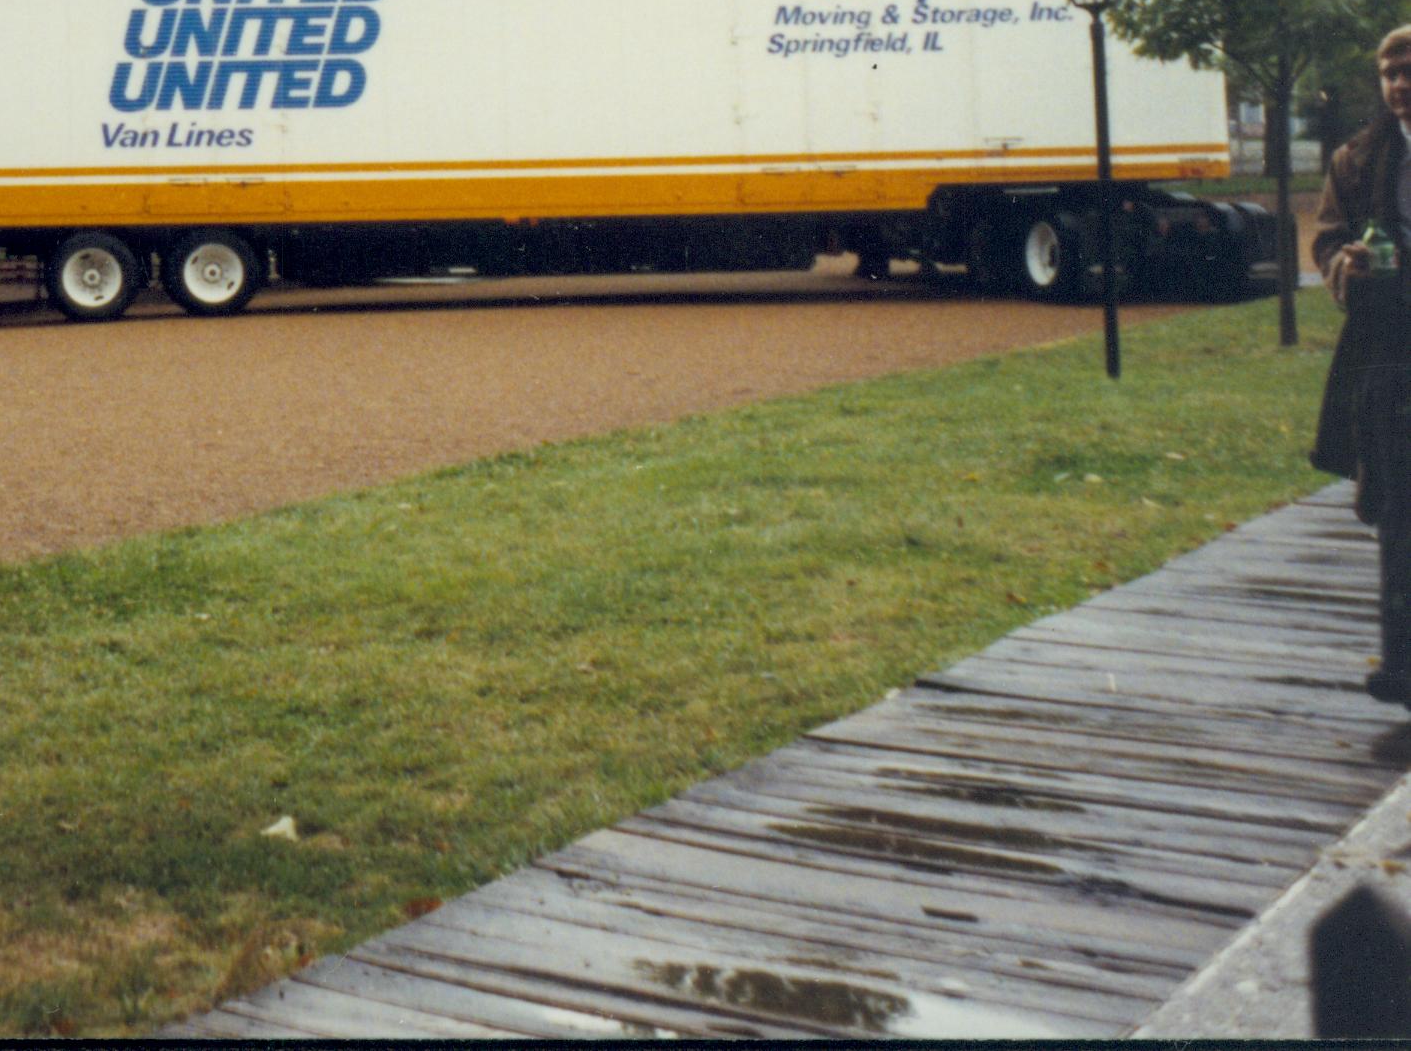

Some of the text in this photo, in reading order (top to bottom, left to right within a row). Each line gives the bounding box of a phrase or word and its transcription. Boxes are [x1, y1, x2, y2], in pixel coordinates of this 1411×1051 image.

[775, 2, 1074, 29] Moving & Storage, Inc.
[124, 5, 381, 58] UNITED
[768, 31, 943, 57] Springfield, IL
[109, 57, 367, 112] UNITED
[101, 122, 254, 148] Van Lines
